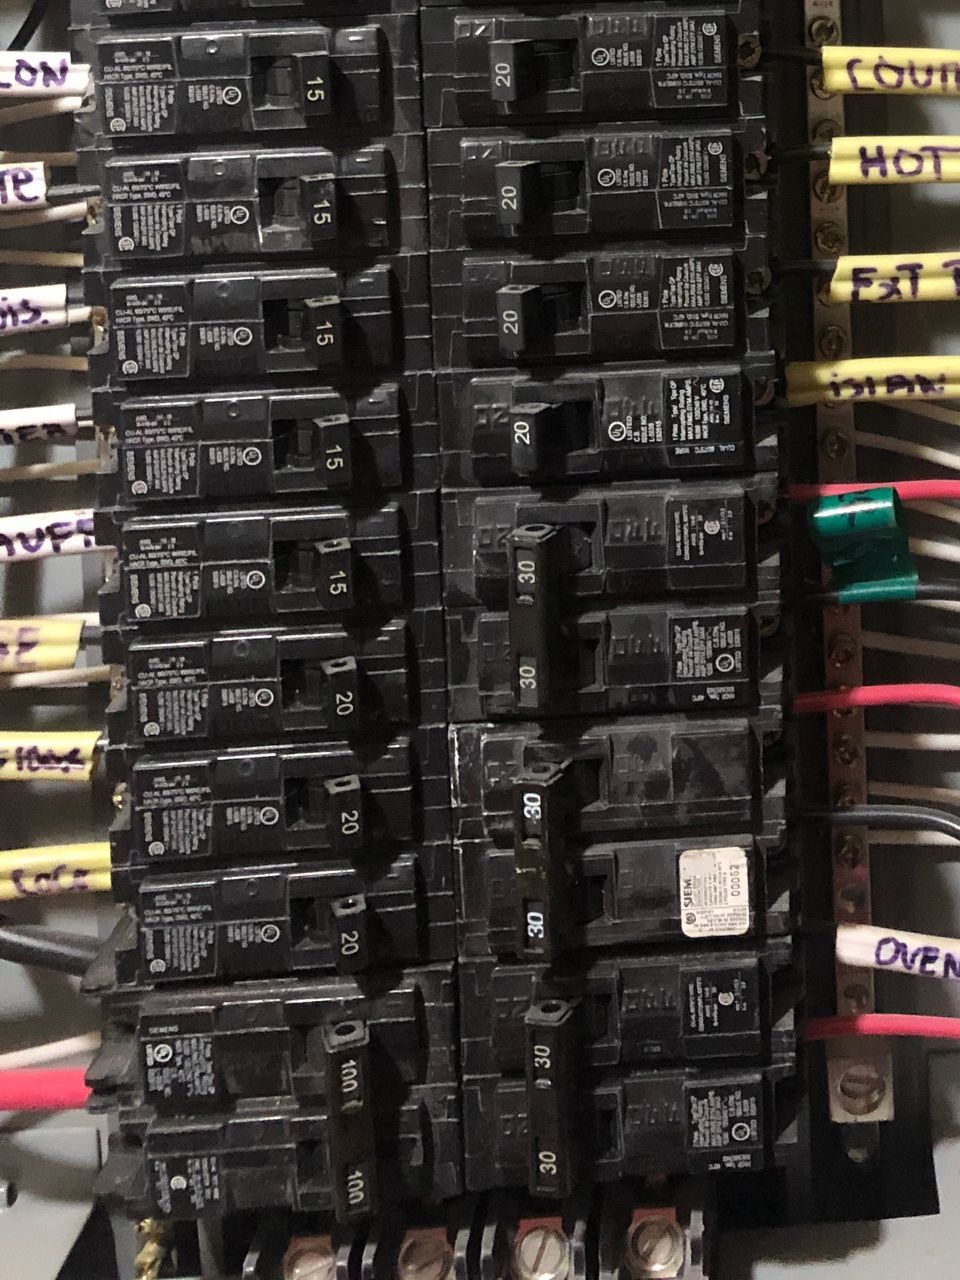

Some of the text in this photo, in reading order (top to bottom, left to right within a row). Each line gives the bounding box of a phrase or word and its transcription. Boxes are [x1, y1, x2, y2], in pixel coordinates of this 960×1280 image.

[495, 63, 511, 88] 20
[307, 76, 324, 102] 15
[502, 185, 517, 210] 20
[314, 200, 331, 225] 15
[316, 322, 334, 346] 15
[504, 310, 518, 334] 20
[514, 421, 529, 445] 20
[326, 444, 343, 470] 15
[330, 570, 347, 595] 15
[519, 560, 535, 584] 30
[519, 666, 536, 689] 30
[336, 691, 353, 716] 20
[524, 792, 541, 819] 30
[342, 811, 358, 835] 20
[527, 912, 544, 938] 30
[341, 931, 358, 955] 20
[535, 1045, 550, 1069] 30
[340, 1059, 358, 1093] 100
[539, 1151, 556, 1175] 30
[347, 1170, 364, 1205] 100
